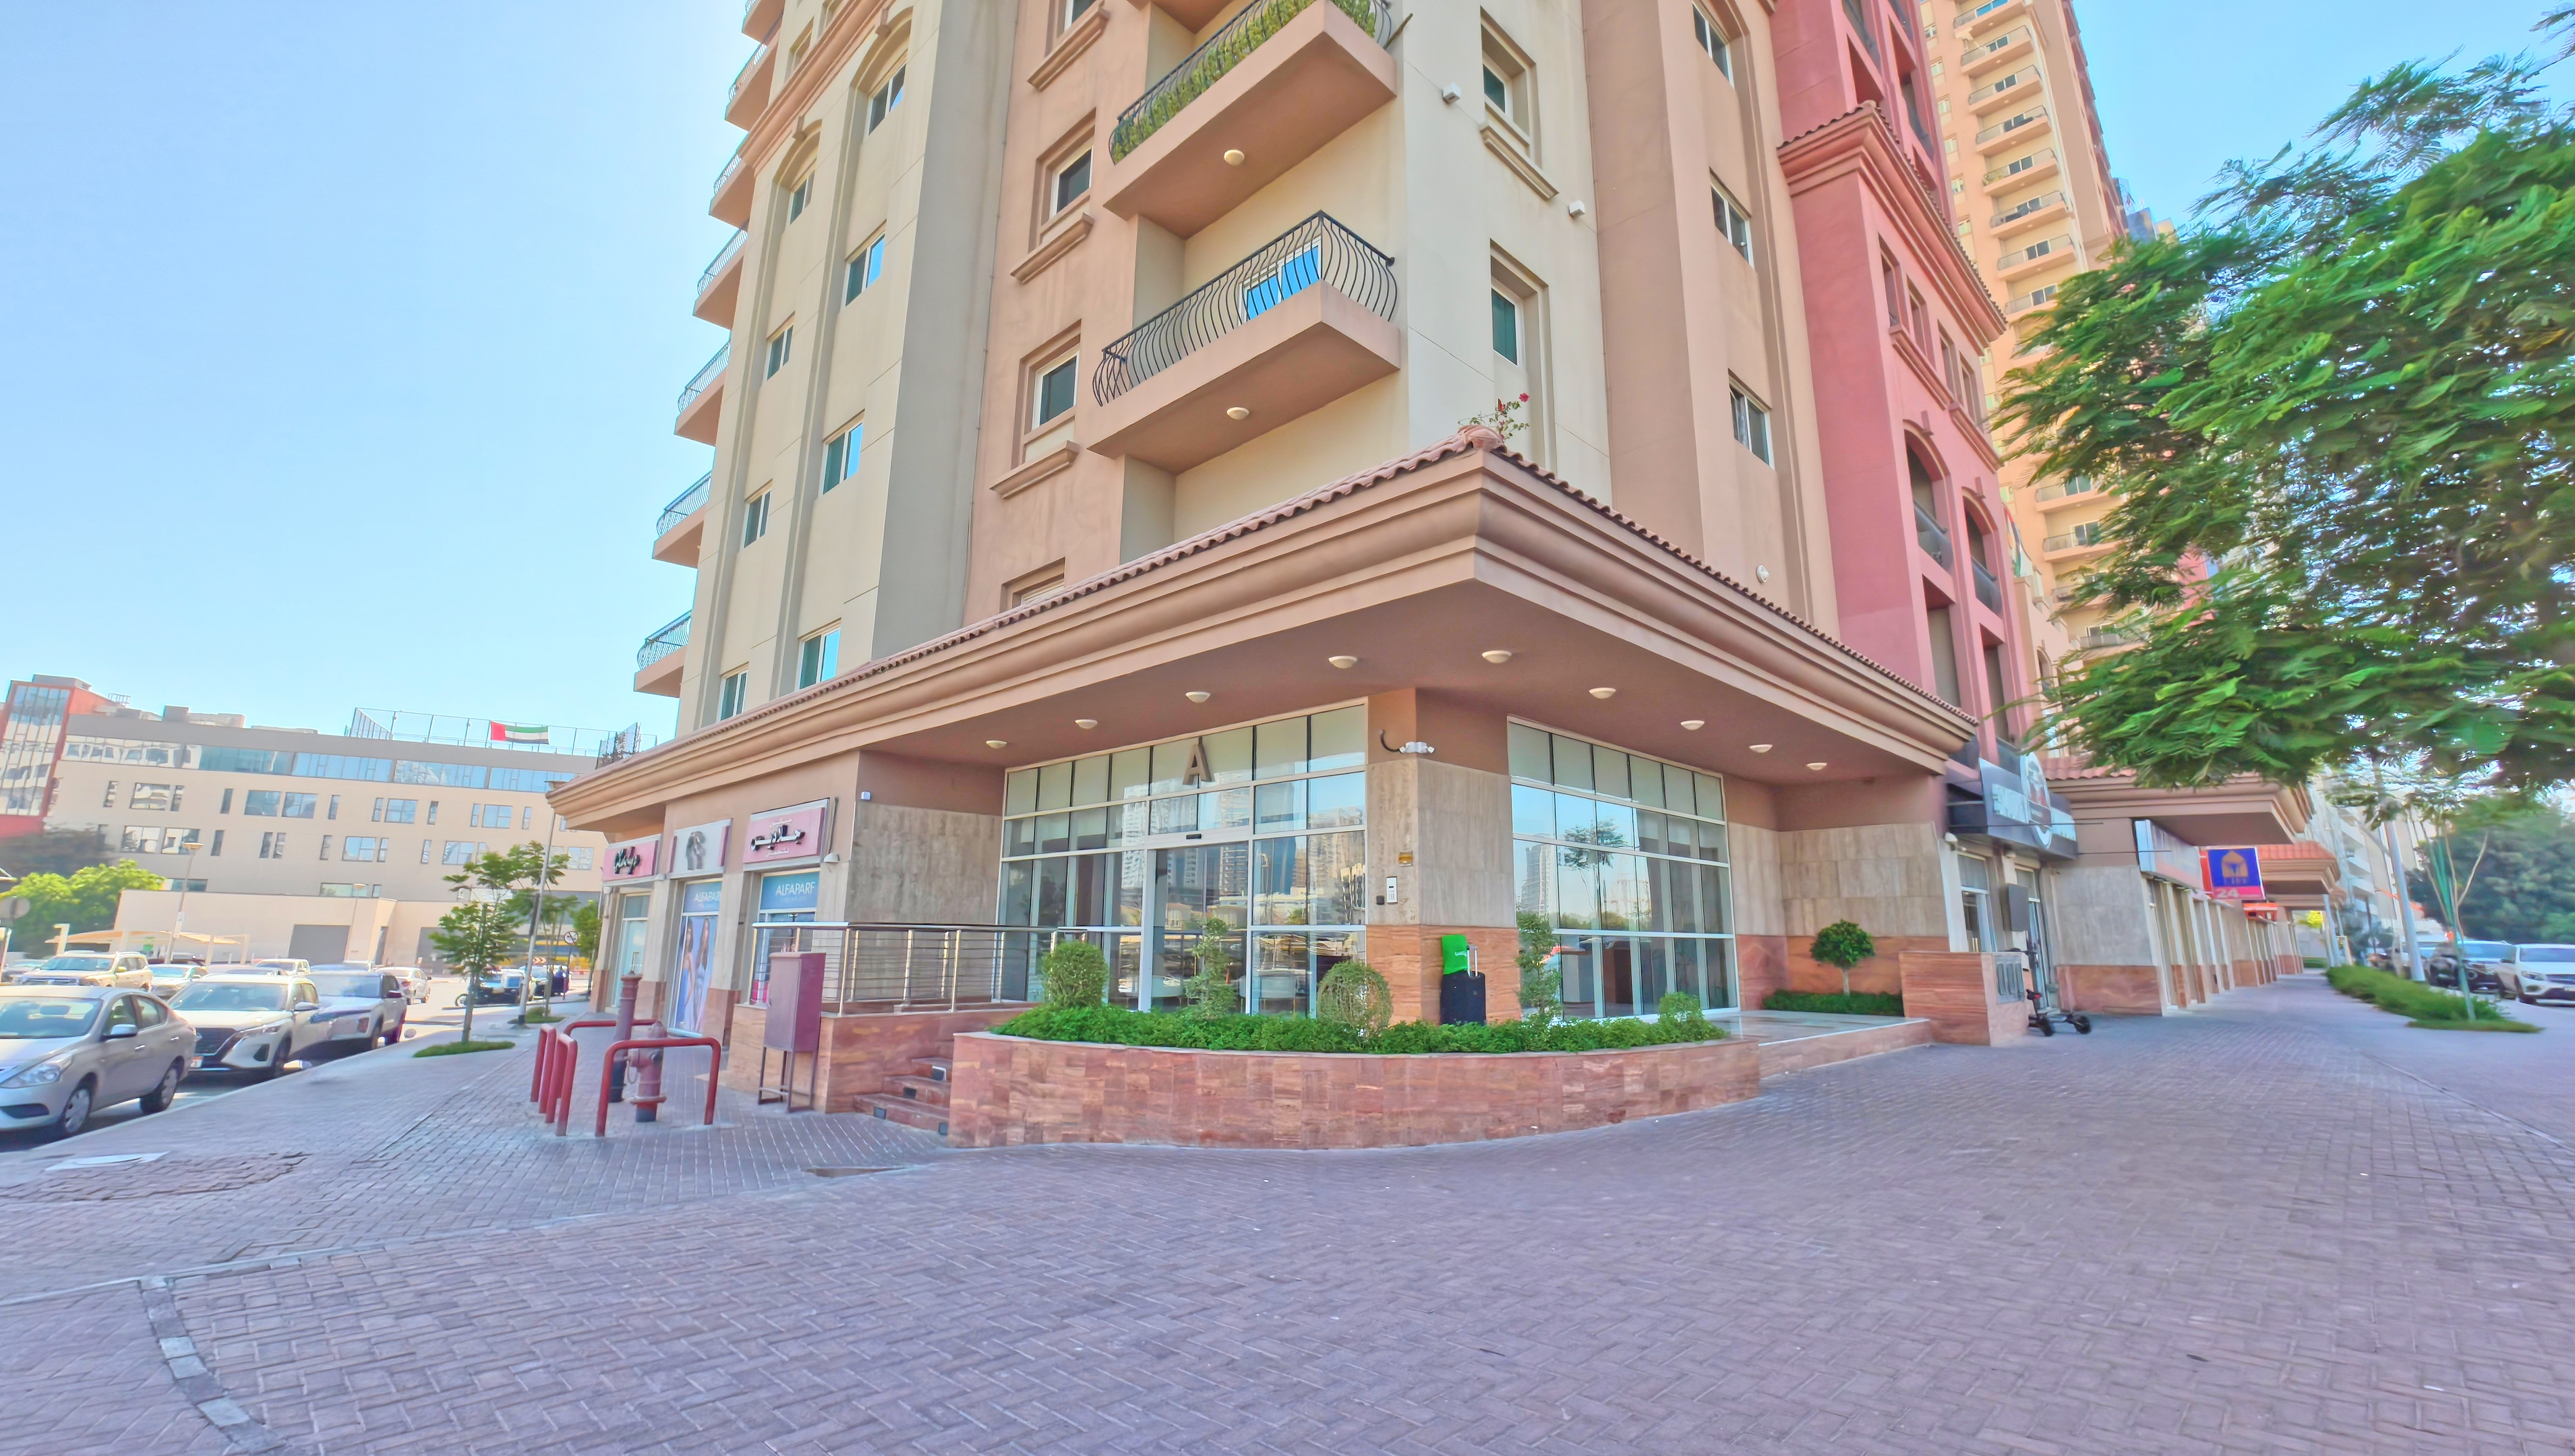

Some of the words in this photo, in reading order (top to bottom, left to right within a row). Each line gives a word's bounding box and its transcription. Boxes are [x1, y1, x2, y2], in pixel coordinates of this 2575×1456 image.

[1182, 745, 1212, 785] A
[775, 882, 816, 896] ALFAPARF
[2216, 888, 2239, 899] 24
